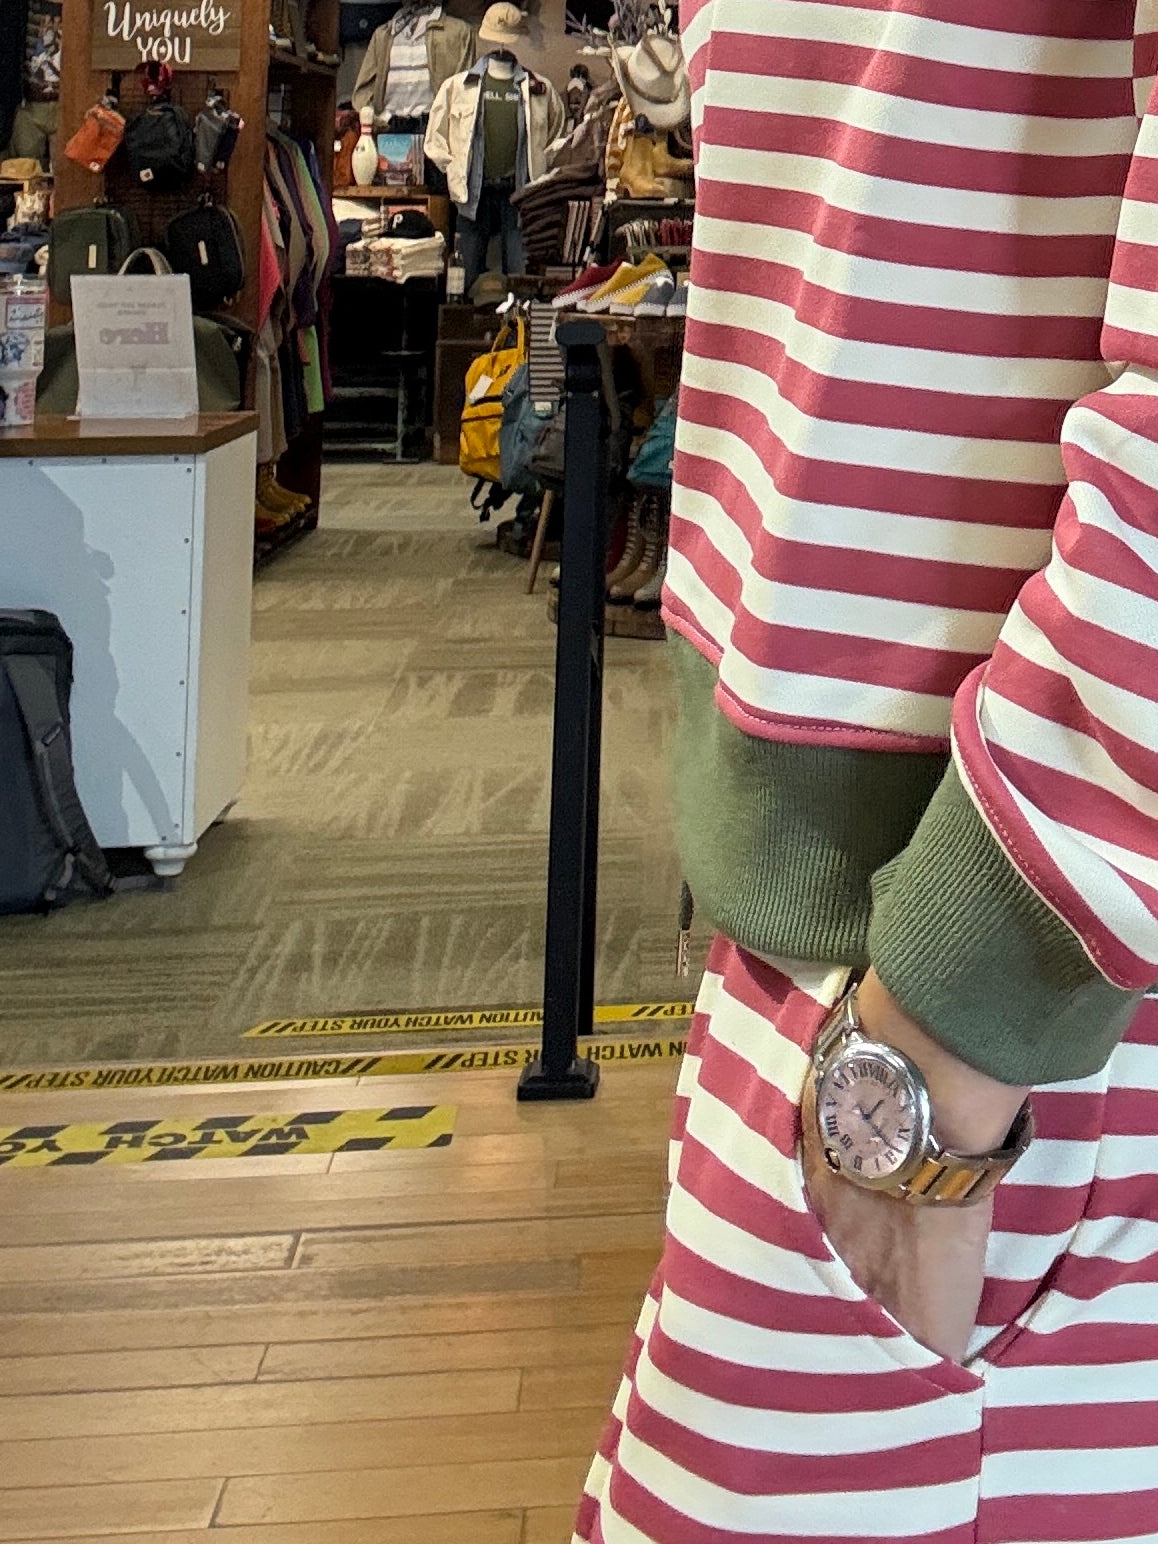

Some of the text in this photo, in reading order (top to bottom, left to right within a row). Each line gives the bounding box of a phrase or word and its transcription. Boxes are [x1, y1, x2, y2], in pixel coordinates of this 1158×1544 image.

[136, 36, 191, 64] YOU
[293, 1018, 345, 1034] STEP
[350, 1016, 401, 1032] YOUR
[404, 1012, 474, 1029] WATCH
[461, 1050, 518, 1068] STEP
[587, 1042, 662, 1062] WATCH
[26, 1059, 342, 1089] CAUTION WATCH YOUR STEP
[104, 1126, 310, 1150] WATCH
